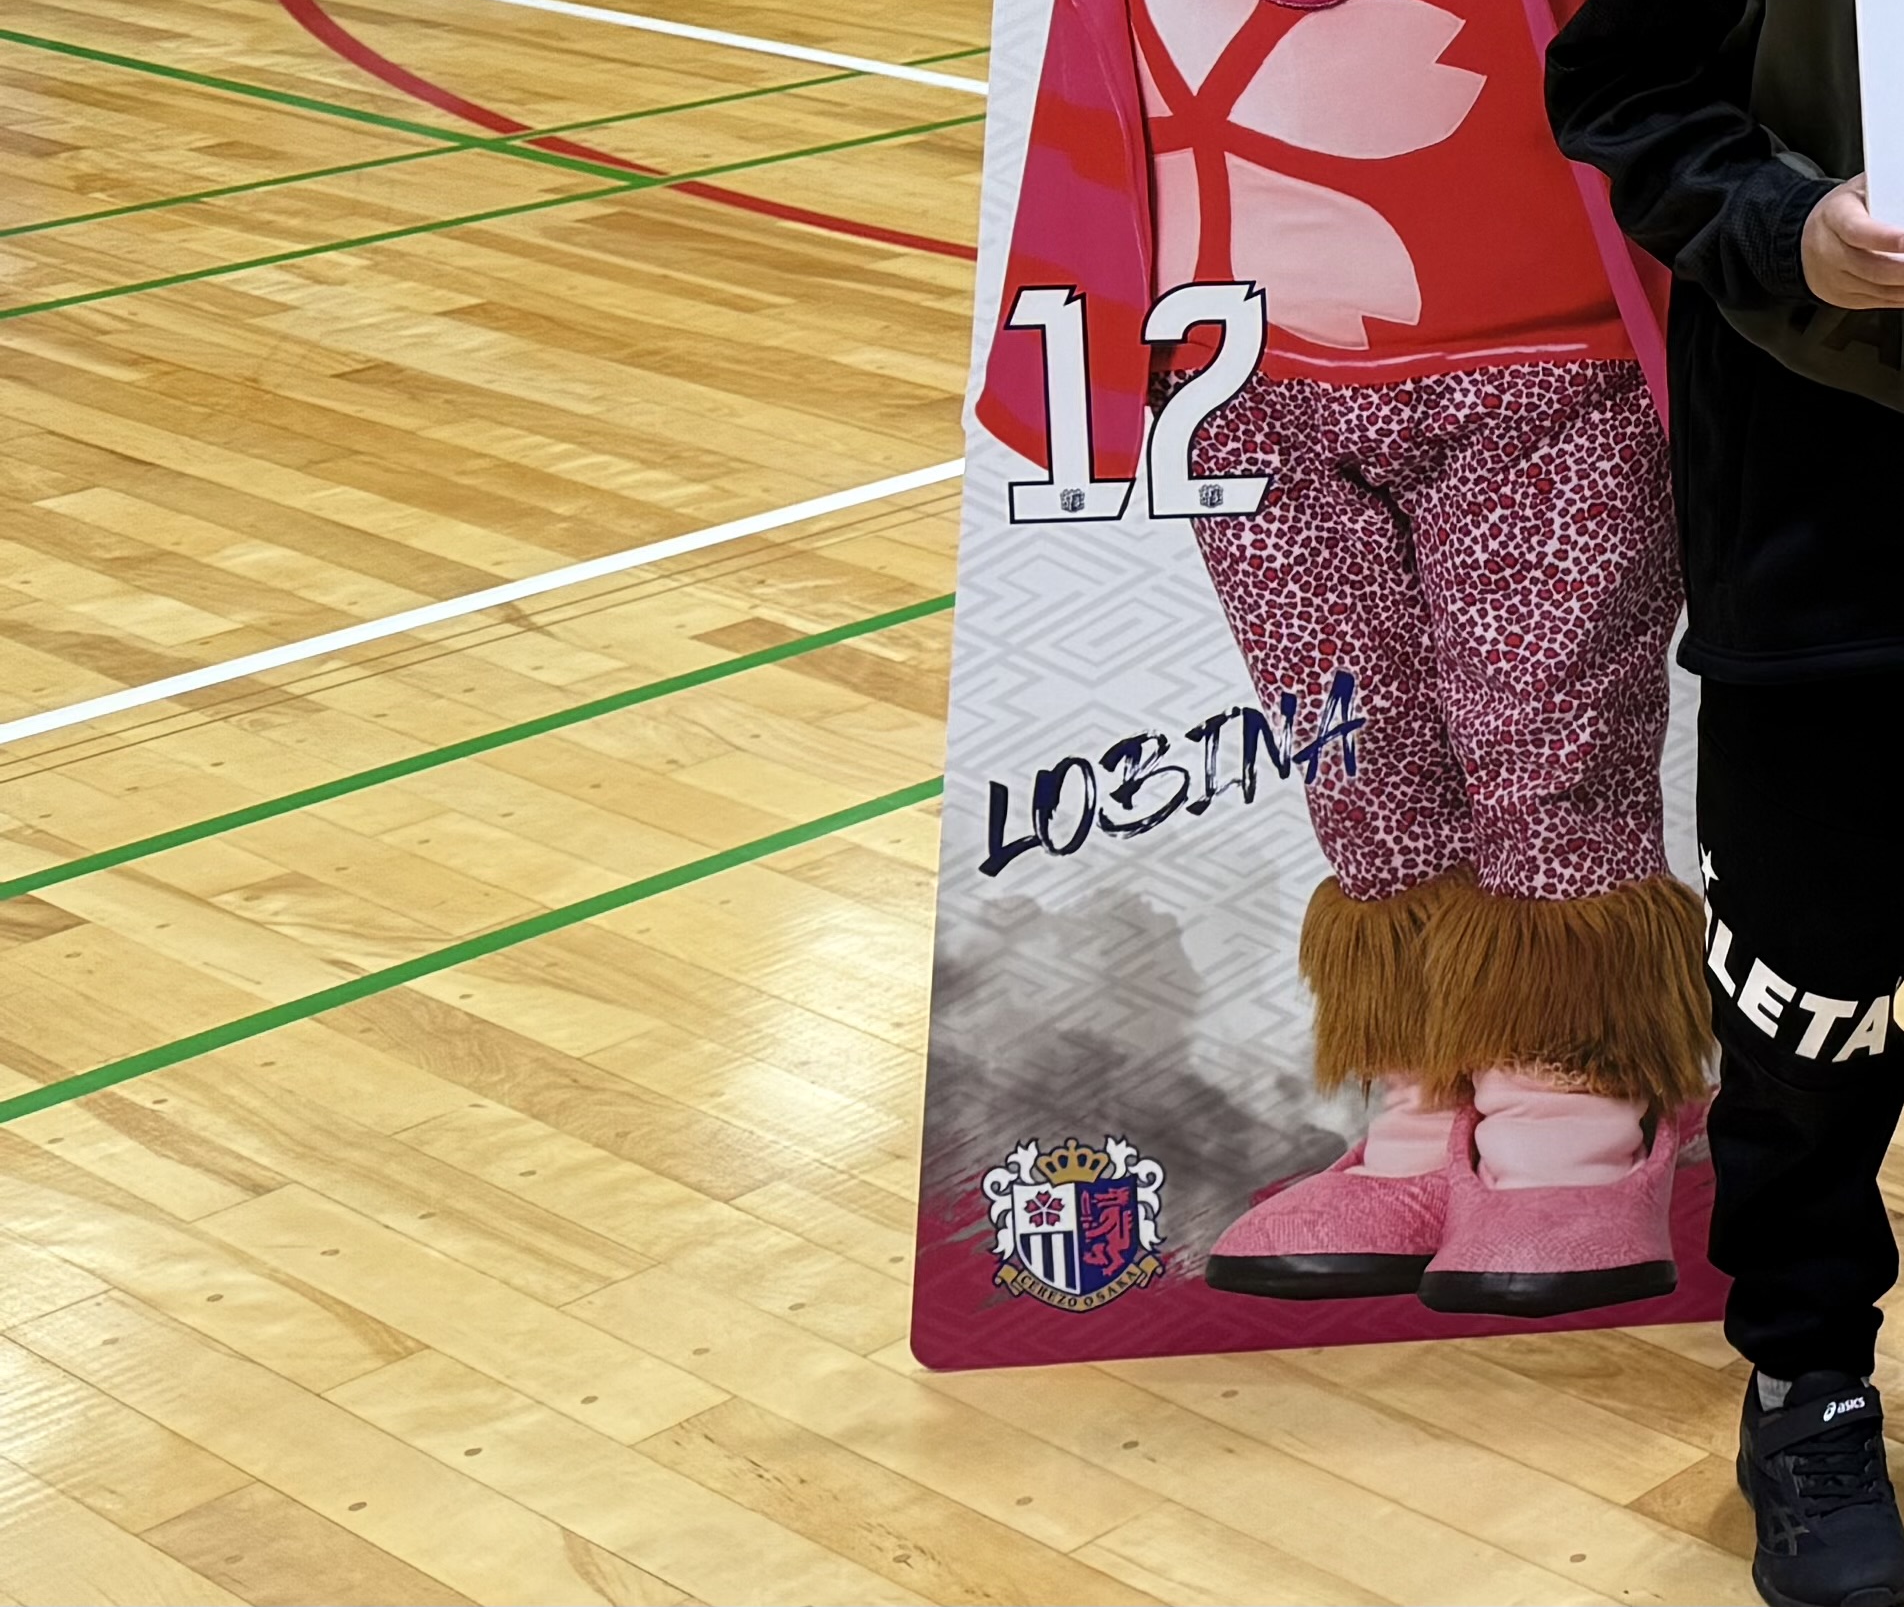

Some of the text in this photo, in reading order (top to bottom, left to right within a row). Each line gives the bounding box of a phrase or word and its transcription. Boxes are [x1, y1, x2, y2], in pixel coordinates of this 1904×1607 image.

[1003, 280, 1274, 525] 12
[979, 668, 1367, 877] LOBINA
[1704, 897, 1890, 1063] LETA
[1021, 1270, 1138, 1307] CEREZO OSAKA
